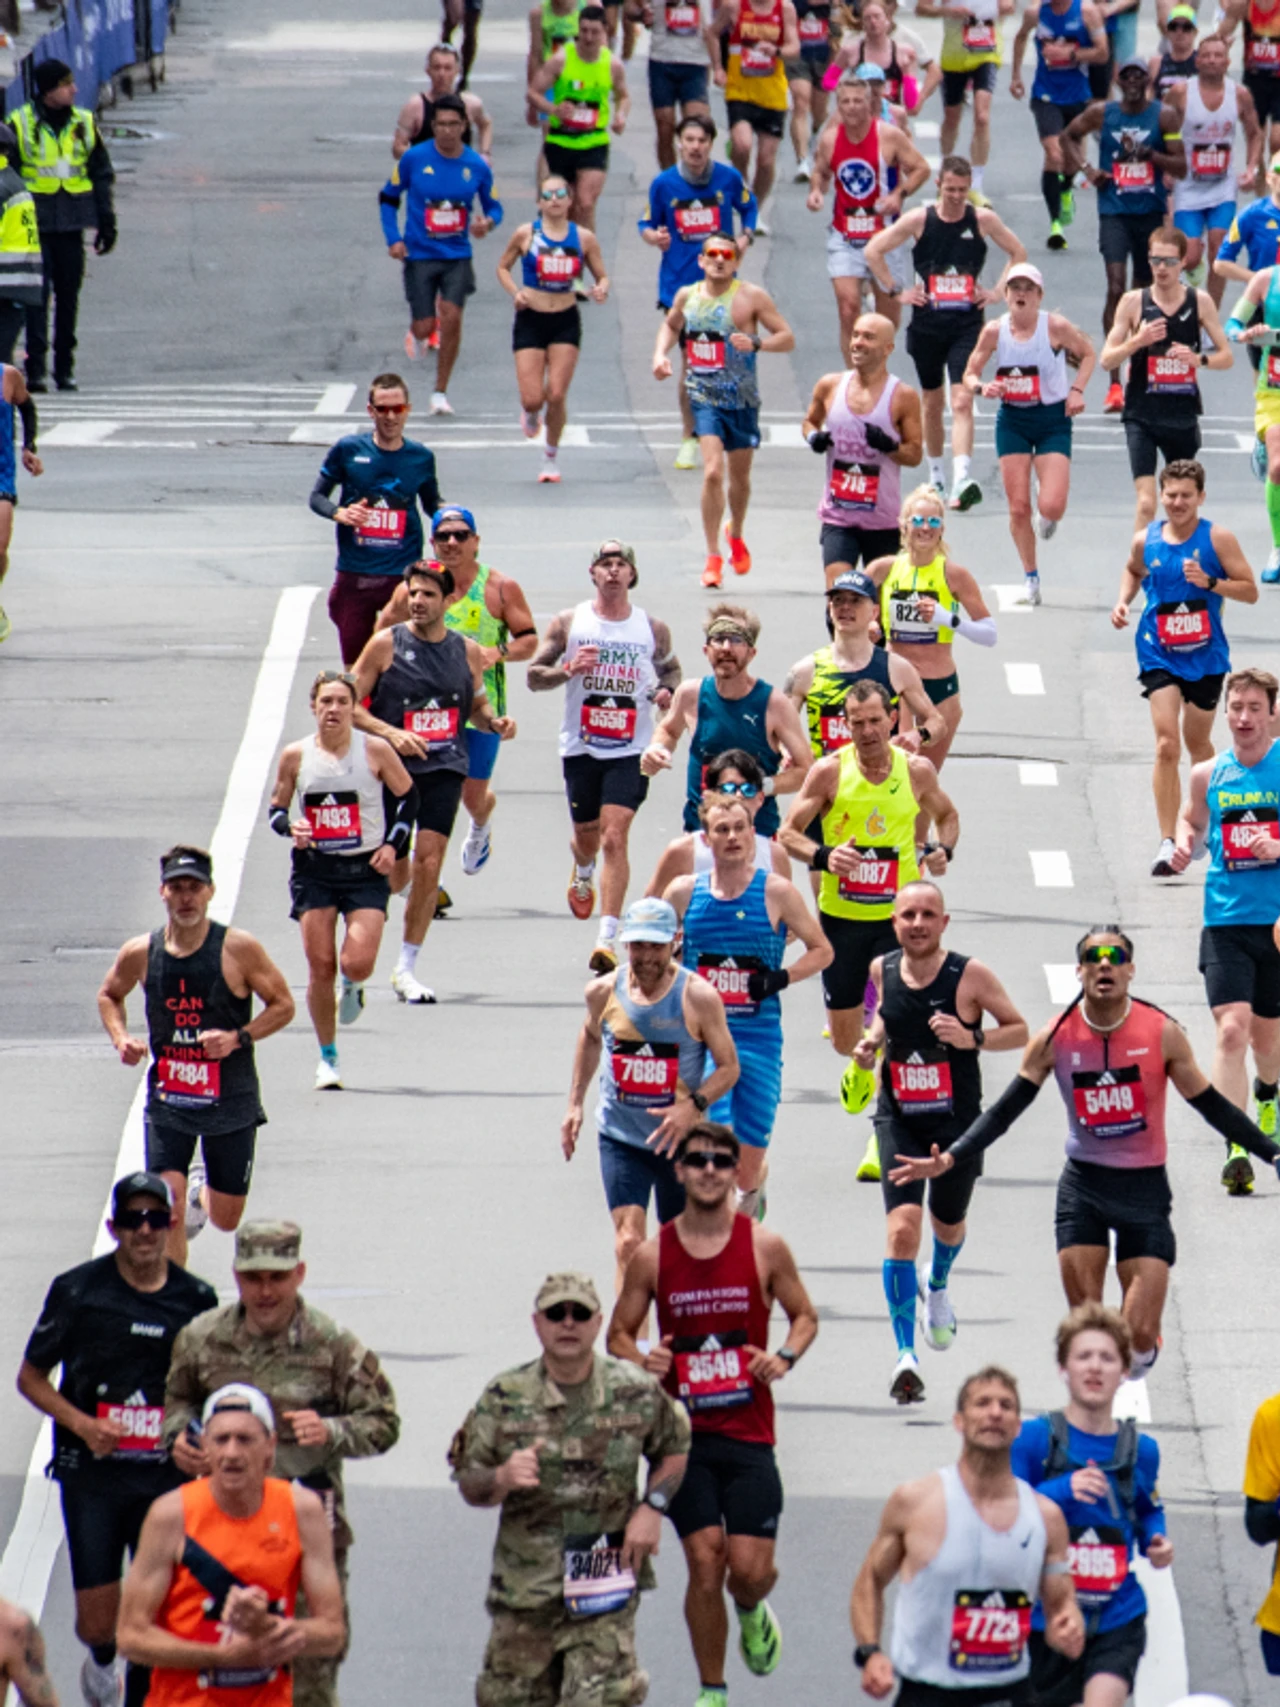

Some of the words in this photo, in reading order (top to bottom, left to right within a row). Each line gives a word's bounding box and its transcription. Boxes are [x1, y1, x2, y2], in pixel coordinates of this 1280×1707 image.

[896, 604, 921, 622] 822
[582, 676, 636, 694] GUARD
[312, 809, 350, 828] 7493
[166, 996, 204, 1010] CAN
[175, 1012, 201, 1026] DO
